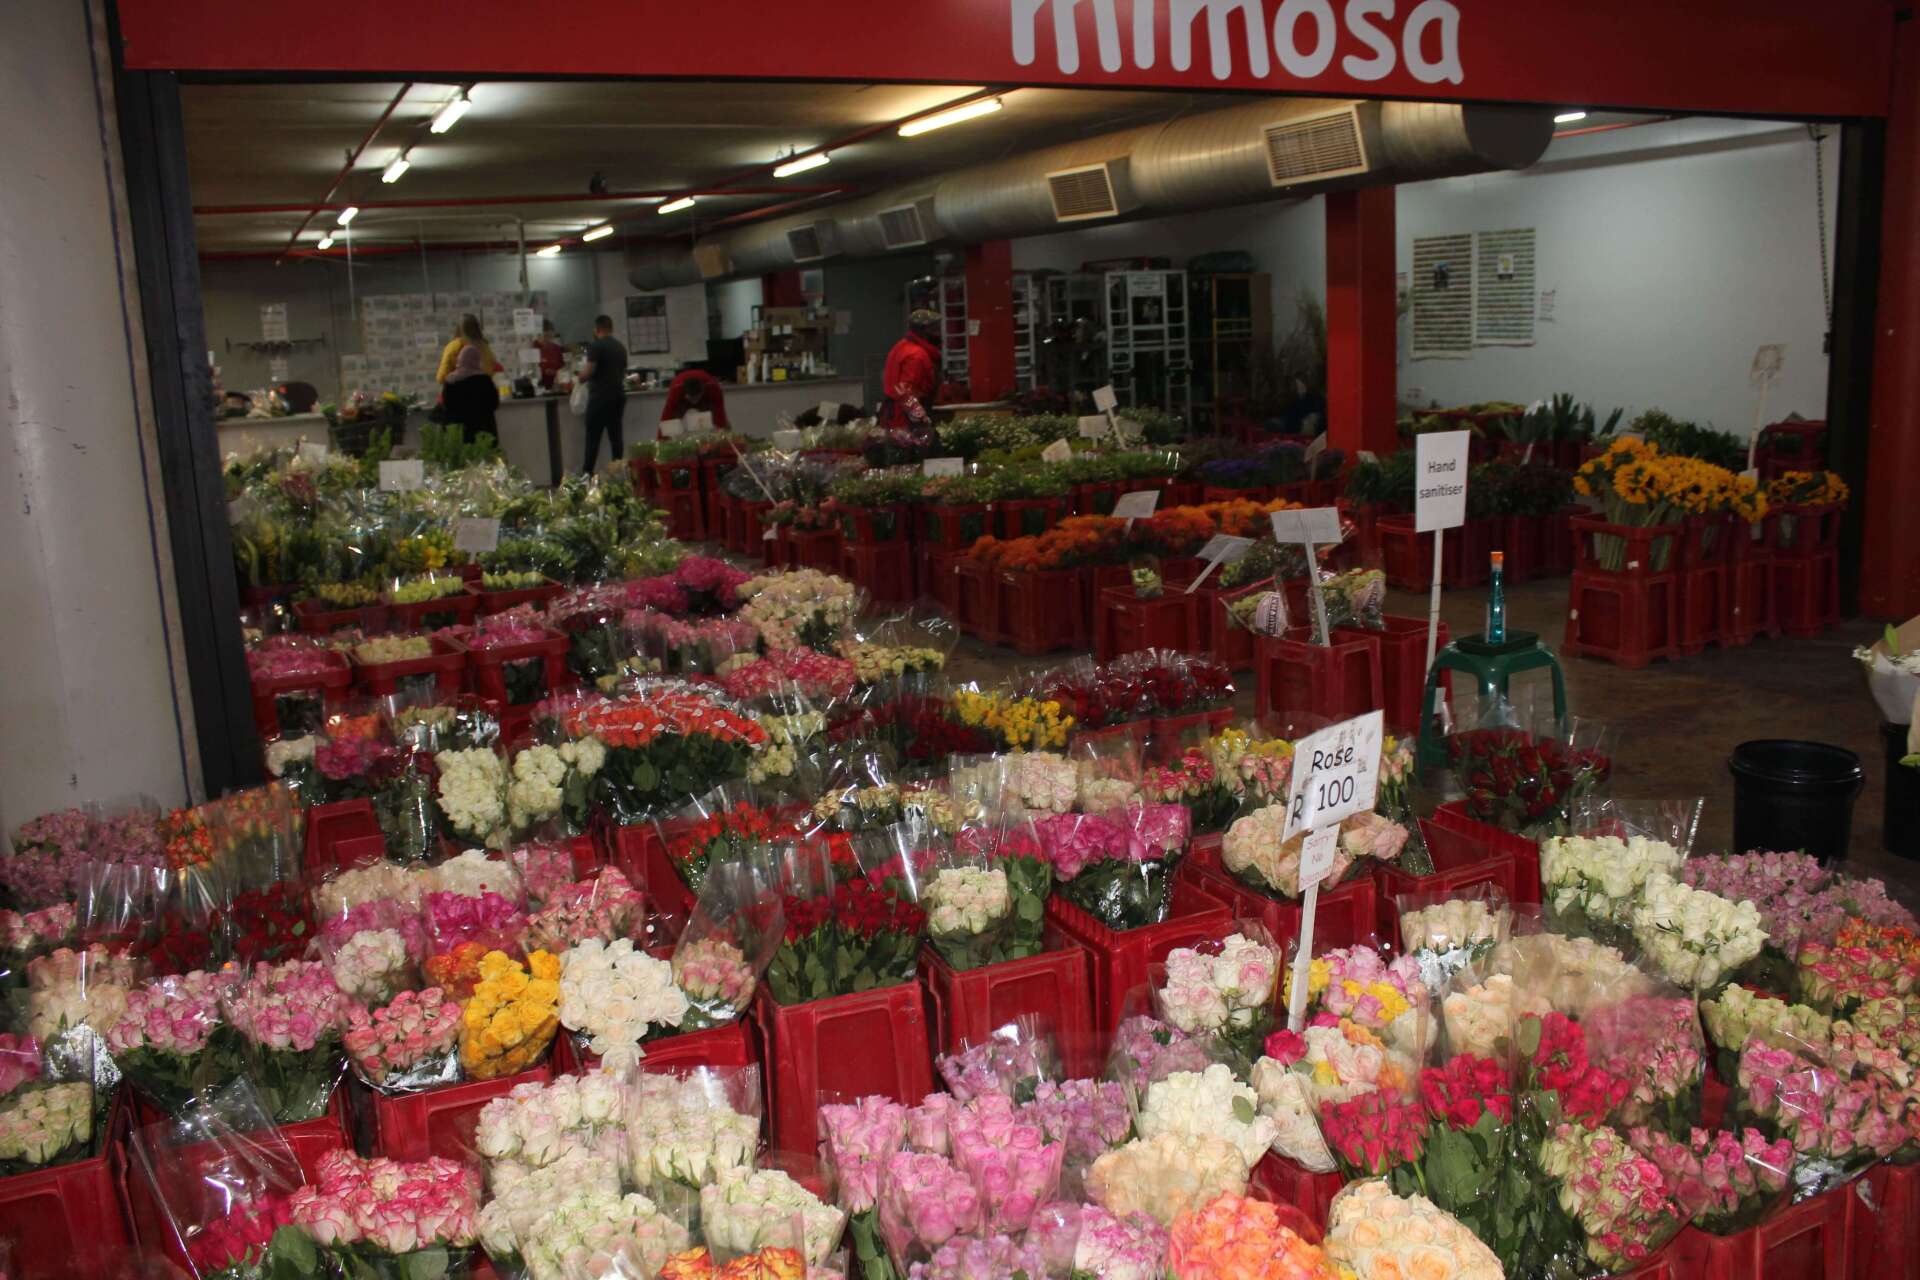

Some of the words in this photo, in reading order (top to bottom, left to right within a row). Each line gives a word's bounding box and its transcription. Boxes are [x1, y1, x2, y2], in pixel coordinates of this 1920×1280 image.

[1011, 0, 1464, 85] mimosa
[1427, 459, 1457, 474] Hand
[1419, 483, 1464, 499] sanitiser
[1311, 746, 1354, 774] Rose
[1290, 792, 1305, 827] R
[1317, 775, 1355, 812] 100
